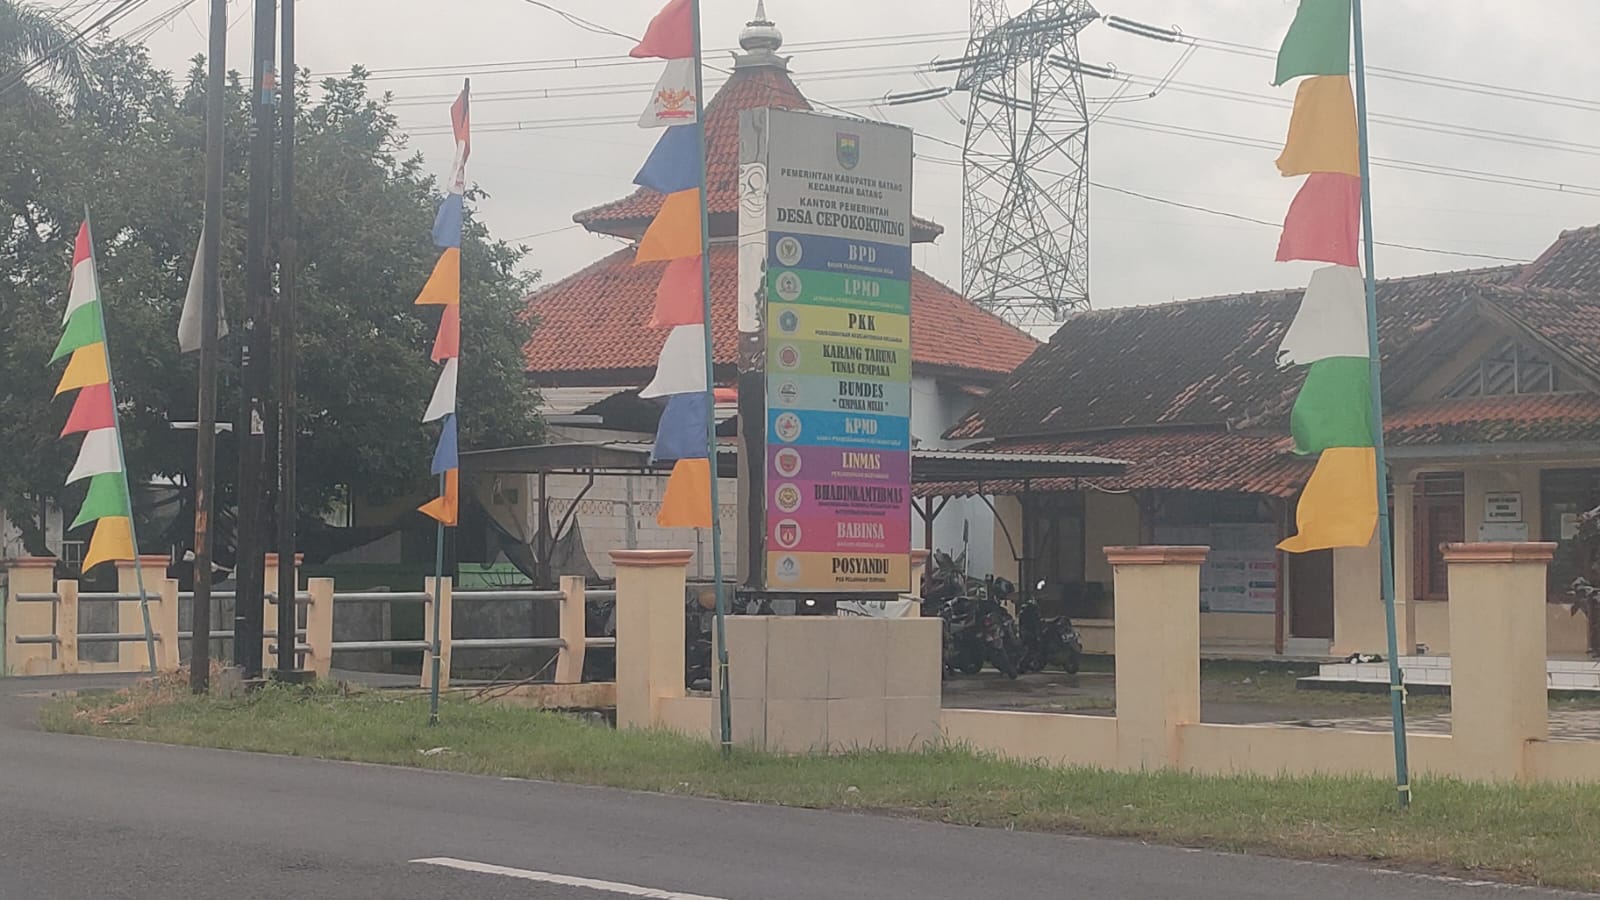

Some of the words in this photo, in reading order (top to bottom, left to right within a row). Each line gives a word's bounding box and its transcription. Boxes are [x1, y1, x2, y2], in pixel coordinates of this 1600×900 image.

[781, 168, 833, 180] PEMERINTAH
[835, 174, 877, 187] KABUPATEN
[878, 180, 903, 192] BATANG
[808, 182, 854, 195] KECAMATAN
[856, 189, 883, 199] BATANG
[800, 197, 837, 209] KANTOR
[839, 201, 889, 217] PEMERINTAH
[777, 207, 813, 225] DESA
[816, 211, 904, 237] CEPOKOKUNING
[849, 244, 876, 263] BPD
[844, 278, 880, 297] LPMD
[848, 313, 875, 331] PKK
[823, 344, 863, 361] KARANG
[865, 348, 897, 364] TARUNA
[831, 361, 856, 374] TUNAS
[858, 363, 890, 377] CEMPAKA
[839, 381, 884, 398] BUMDES
[845, 417, 878, 435] KPMD
[842, 452, 881, 470] LINMAS
[837, 522, 885, 539] BABINSA
[832, 557, 889, 574] POSYANDU
